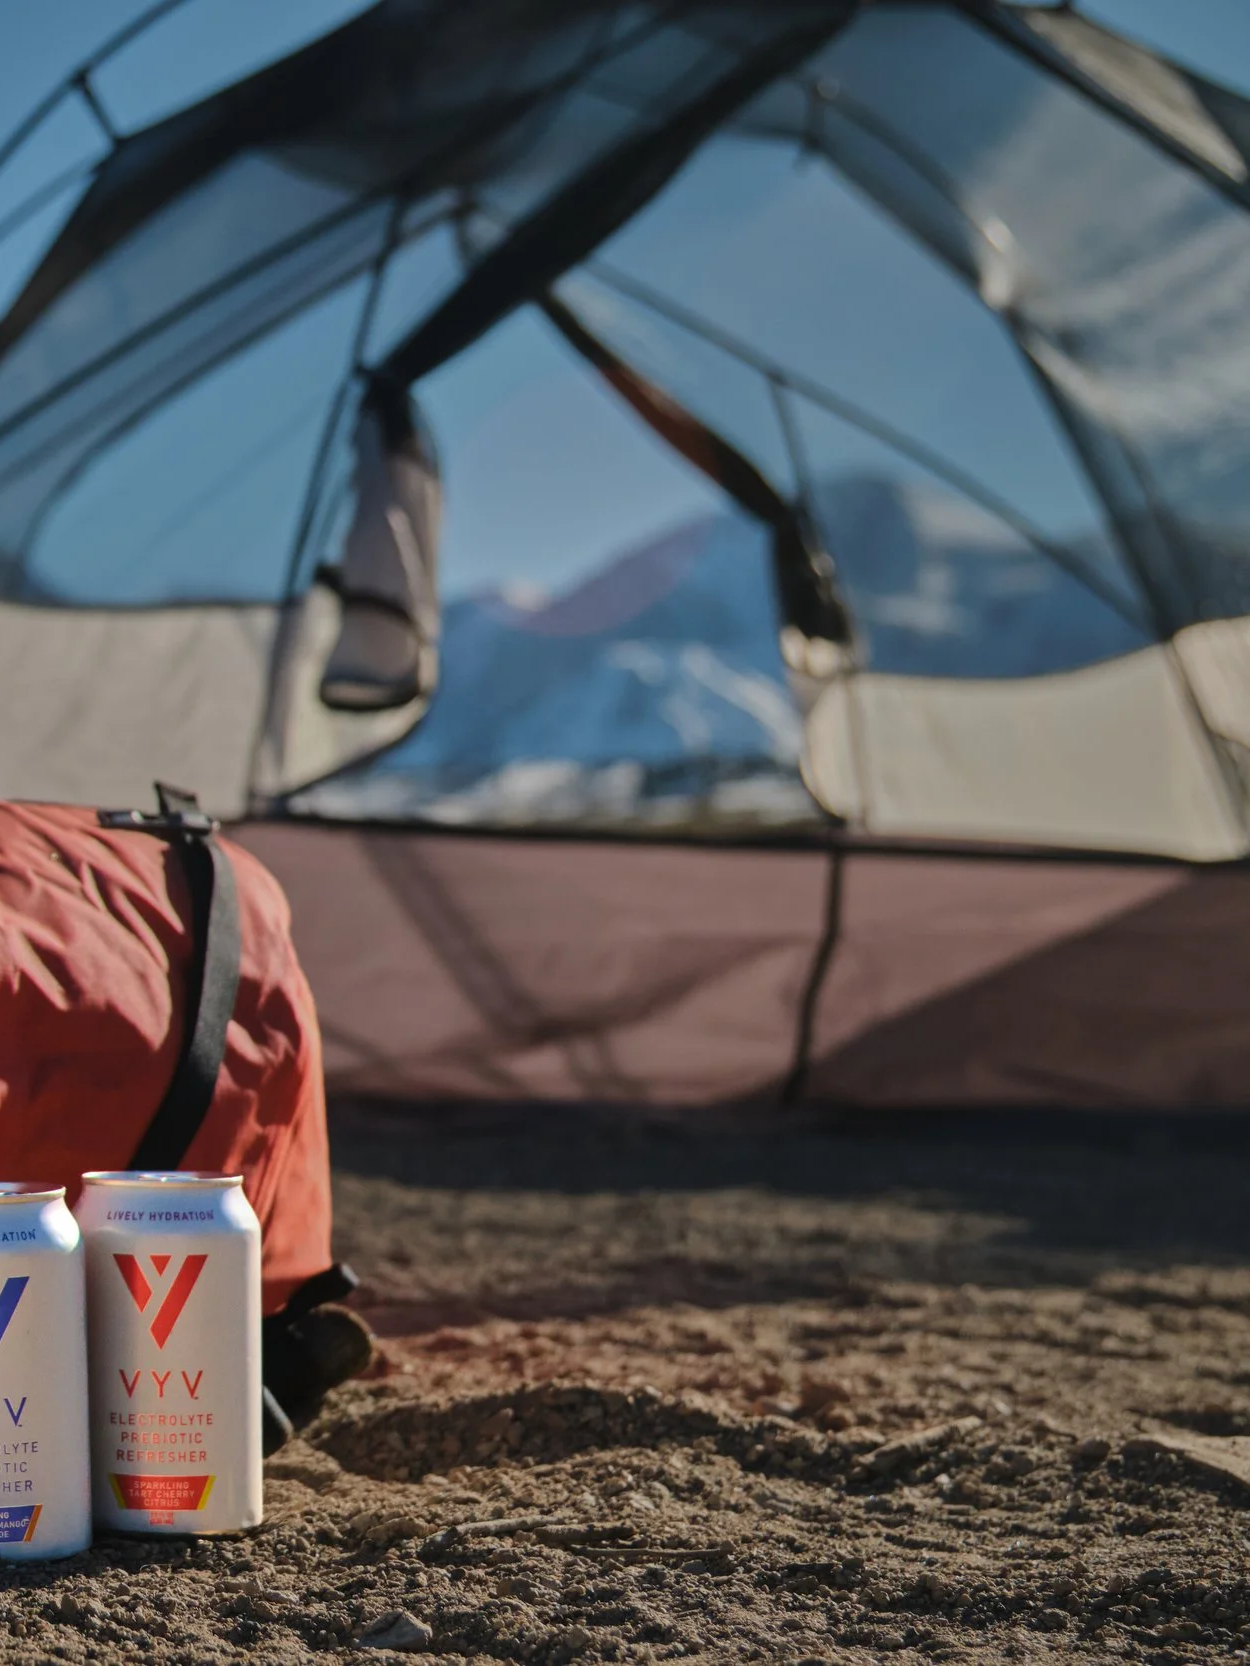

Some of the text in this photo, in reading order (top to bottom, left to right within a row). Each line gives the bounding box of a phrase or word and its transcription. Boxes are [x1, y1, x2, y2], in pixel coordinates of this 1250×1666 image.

[107, 1210, 214, 1221] LIVELY HYDRATION
[119, 1369, 203, 1399] VYV
[109, 1412, 214, 1426] ELECTROLYTE
[121, 1431, 203, 1444] PREBIOTIC
[116, 1449, 207, 1463] REFRESHER
[133, 1481, 190, 1490] SPARKLING
[128, 1489, 195, 1498] TART CHERRY
[144, 1498, 180, 1507] CITRUS
